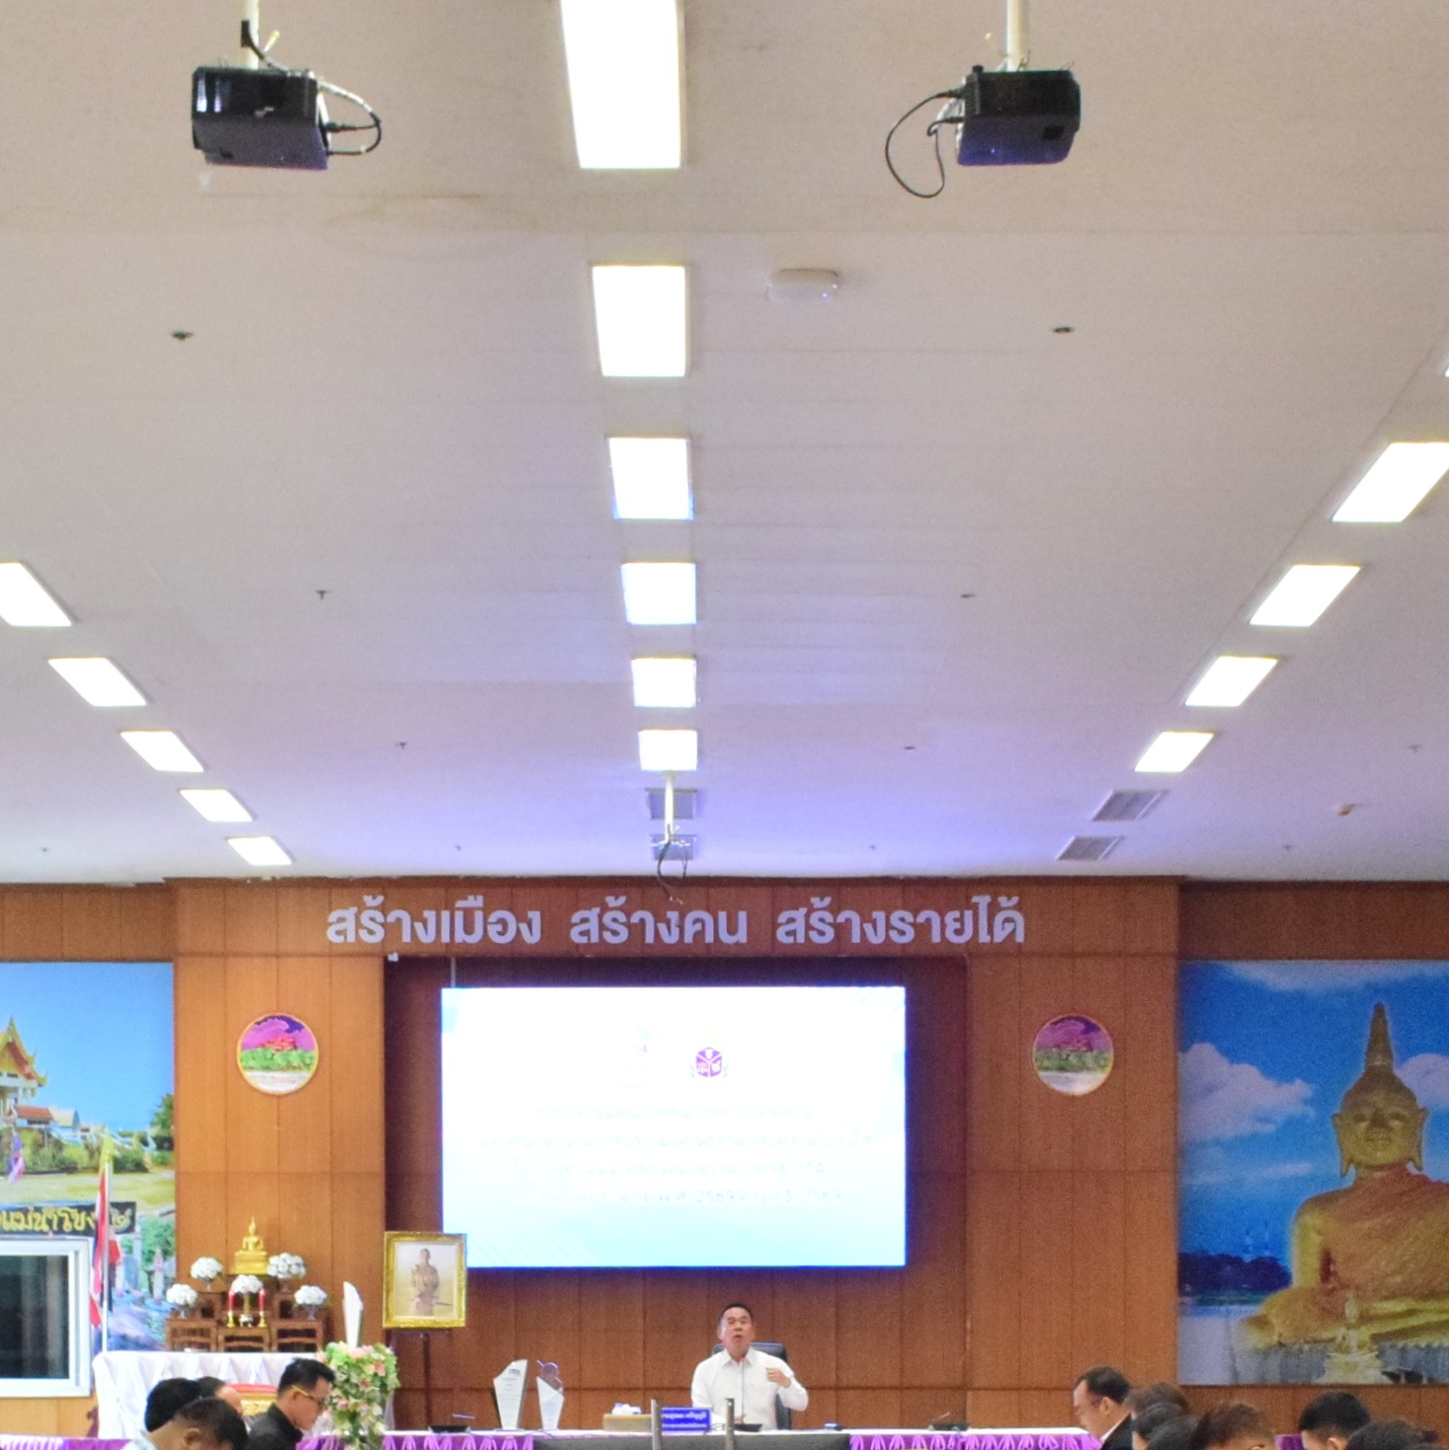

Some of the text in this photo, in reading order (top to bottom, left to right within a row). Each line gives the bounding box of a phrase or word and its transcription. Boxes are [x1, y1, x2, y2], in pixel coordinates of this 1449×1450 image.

[327, 895, 1026, 944] สร้างเมือง สร้างคน สร้างรายได้
